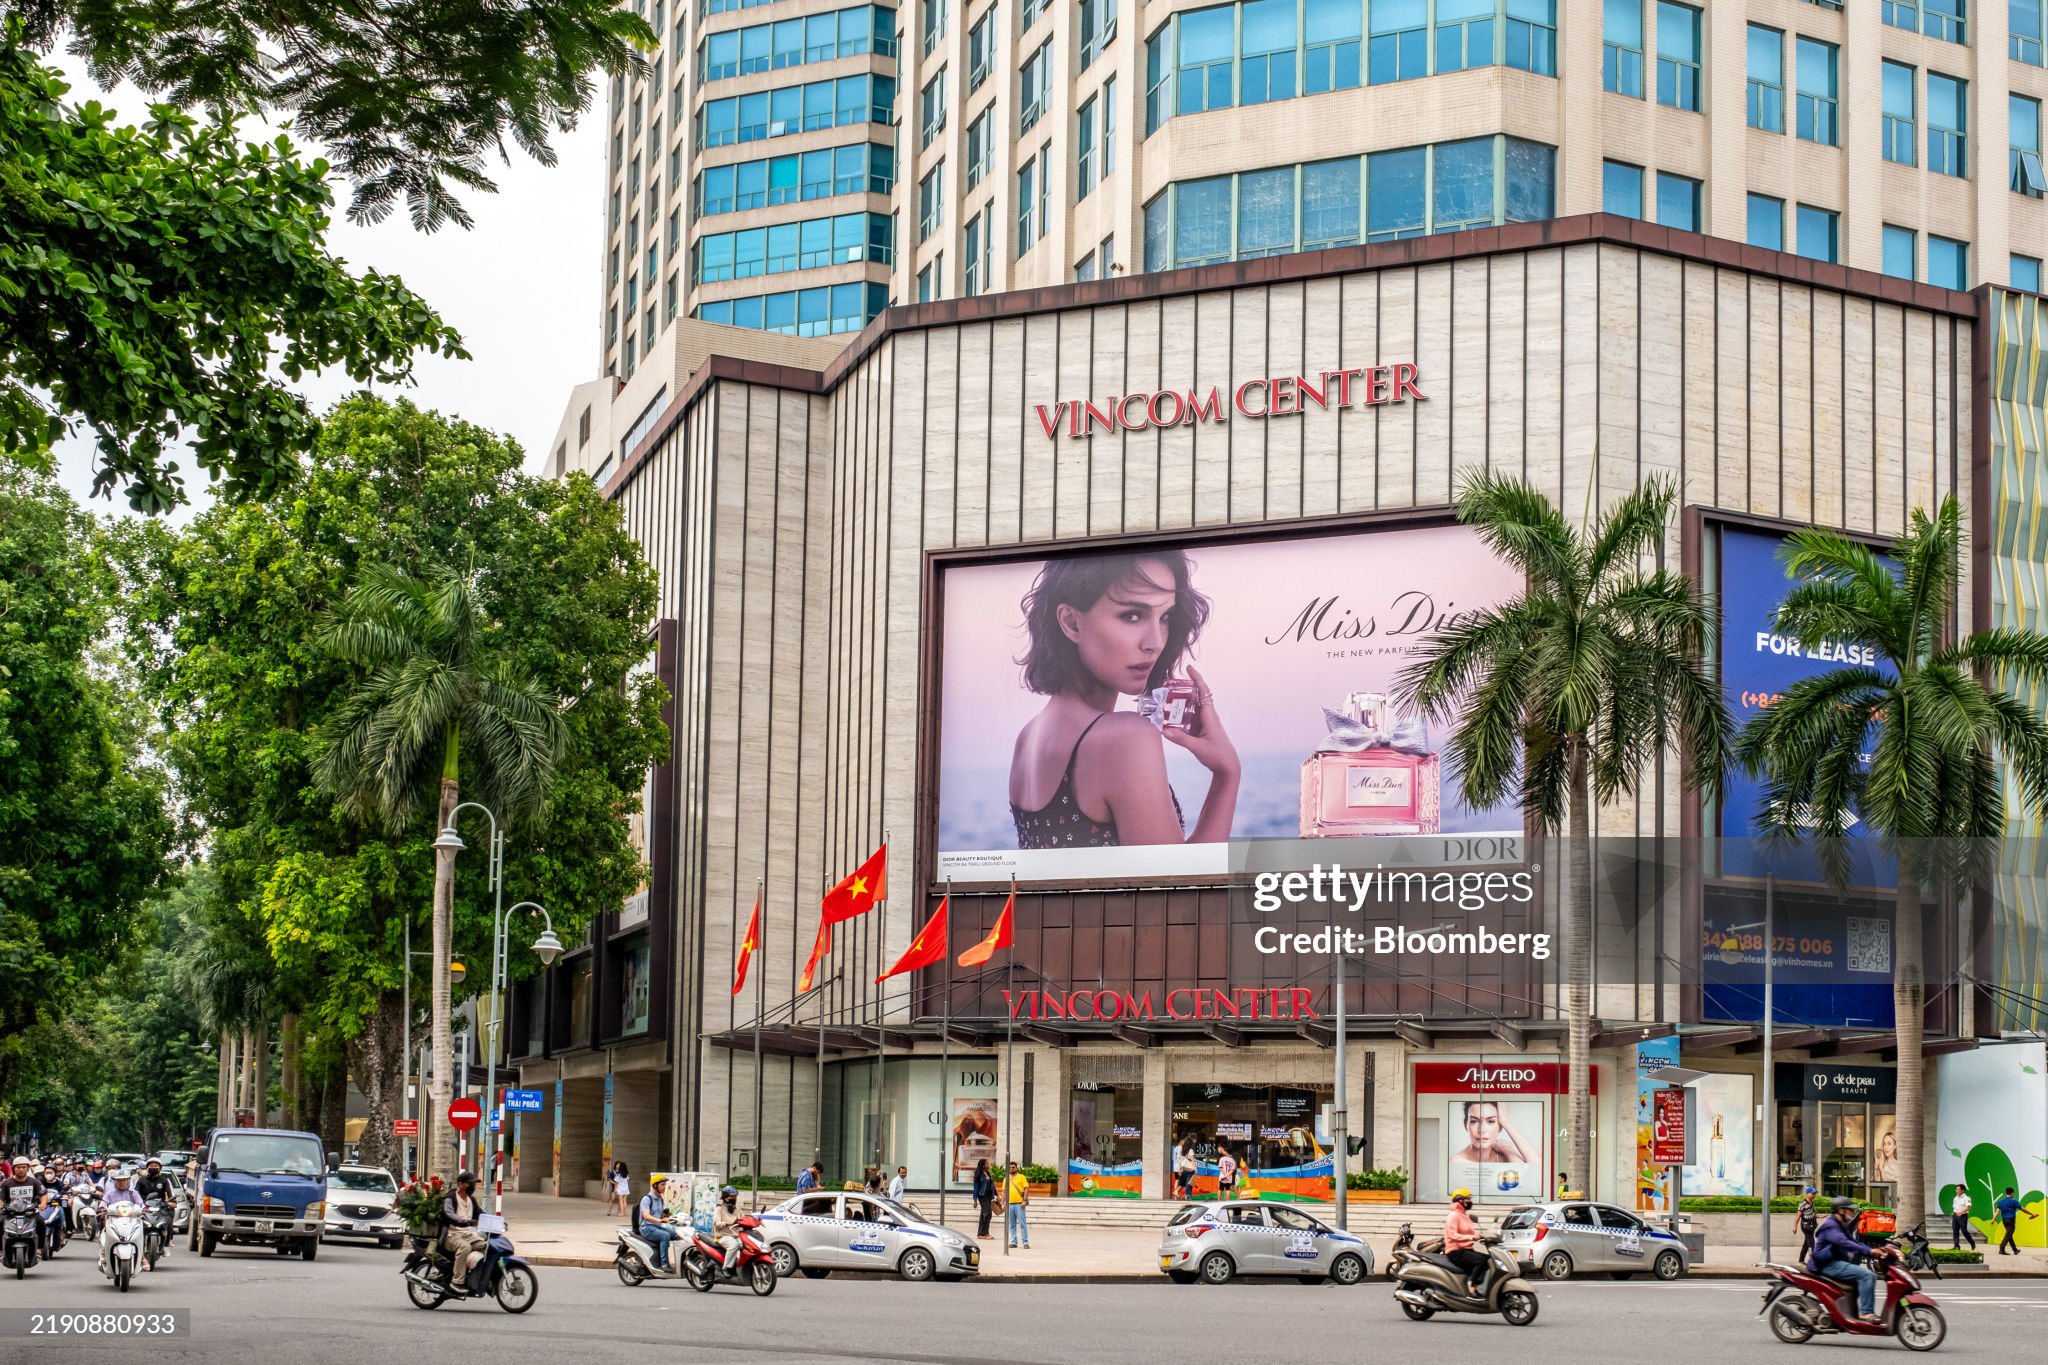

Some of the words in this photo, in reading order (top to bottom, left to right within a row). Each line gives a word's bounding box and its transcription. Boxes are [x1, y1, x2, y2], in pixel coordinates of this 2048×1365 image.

[1033, 385, 1228, 439] VINCOM
[1235, 363, 1429, 417] CENTER
[1265, 595, 1376, 646] Miss
[1327, 649, 1345, 659] THE
[1350, 648, 1374, 657] NEW
[1378, 645, 1420, 656] PARFUM
[1756, 632, 1801, 657] FOR
[1806, 641, 1875, 667] LEASE
[1353, 776, 1380, 789] Miss
[1442, 837, 1519, 862] DIOR
[1801, 939, 1833, 955] 006
[1000, 990, 1158, 1021] VINCOM
[1166, 988, 1321, 1020] CENTER
[1457, 1068, 1536, 1083] SHISEIDO
[1833, 1073, 1846, 1085] clé
[1845, 1074, 1857, 1085] de
[1857, 1076, 1876, 1088] peau
[508, 1099, 521, 1107] THÁI
